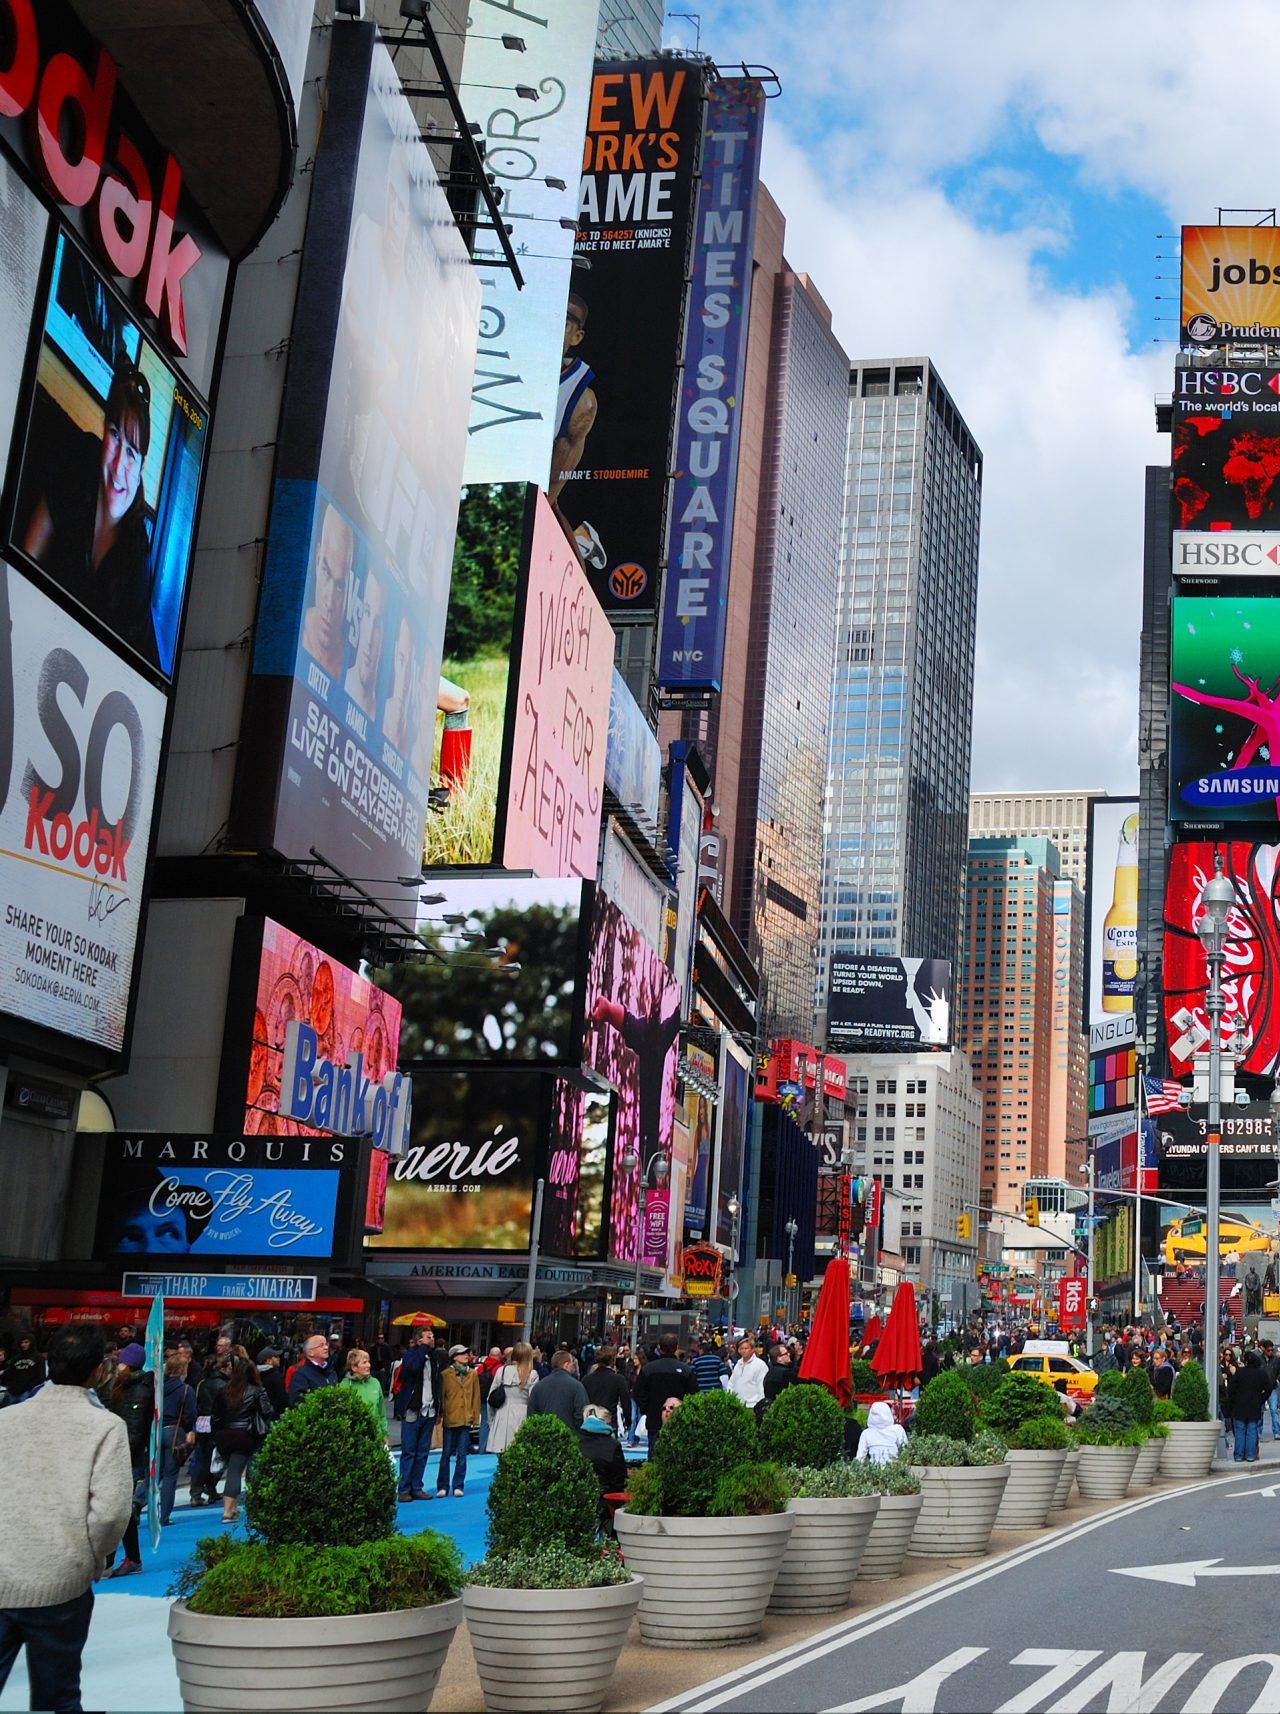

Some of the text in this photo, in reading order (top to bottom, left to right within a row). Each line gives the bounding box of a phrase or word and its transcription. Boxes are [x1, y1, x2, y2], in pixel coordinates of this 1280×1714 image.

[590, 228, 671, 240] TO 564257 (KNICKS)
[702, 131, 749, 329] TIMES
[600, 238, 671, 250] TO MEET AMAR'E
[1179, 371, 1262, 395] HSBC
[1179, 400, 1203, 412] The
[1204, 401, 1250, 413] world's
[1252, 402, 1280, 413] local
[558, 469, 650, 481] AMAR'E STOUDEMIRE
[676, 354, 730, 617] SQUARE
[1179, 542, 1263, 566] HSBC
[1180, 576, 1219, 585] SHERWOOD
[672, 650, 704, 663] NYC
[307, 662, 331, 702] ORTIZ
[20, 647, 145, 848] SO
[291, 719, 326, 771] LIVE
[327, 752, 351, 794] ON
[344, 739, 404, 818] OCTOBER
[404, 804, 419, 835] 23
[23, 786, 132, 883] Kodak
[1183, 821, 1220, 829] SHERWOOD
[5, 904, 118, 972] SHARE YOUR SO KODAK
[25, 941, 99, 988] MOMENT HERE
[833, 963, 898, 973] BEFORE DISASTER
[1053, 918, 1068, 1031] NOVOTEL
[878, 973, 904, 981] WORLD
[864, 1028, 915, 1039] READYNYC.ORG
[1090, 1017, 1135, 1047] INGLO
[288, 1021, 372, 1137] Bank
[371, 1072, 403, 1150] of
[121, 1139, 345, 1163] MARQUIS
[394, 1124, 520, 1181] aerie
[1236, 1144, 1271, 1154] CAN'T BE
[427, 1184, 481, 1193] AERIE.COM
[149, 1170, 324, 1248] Come Fly Away
[649, 1212, 666, 1220] FREE
[409, 1264, 494, 1279] AMERICAN
[684, 1254, 717, 1277] ROXY
[164, 1276, 303, 1299] THARP SINATRA
[222, 1284, 246, 1298] FRANK
[1066, 1280, 1082, 1313] tkts
